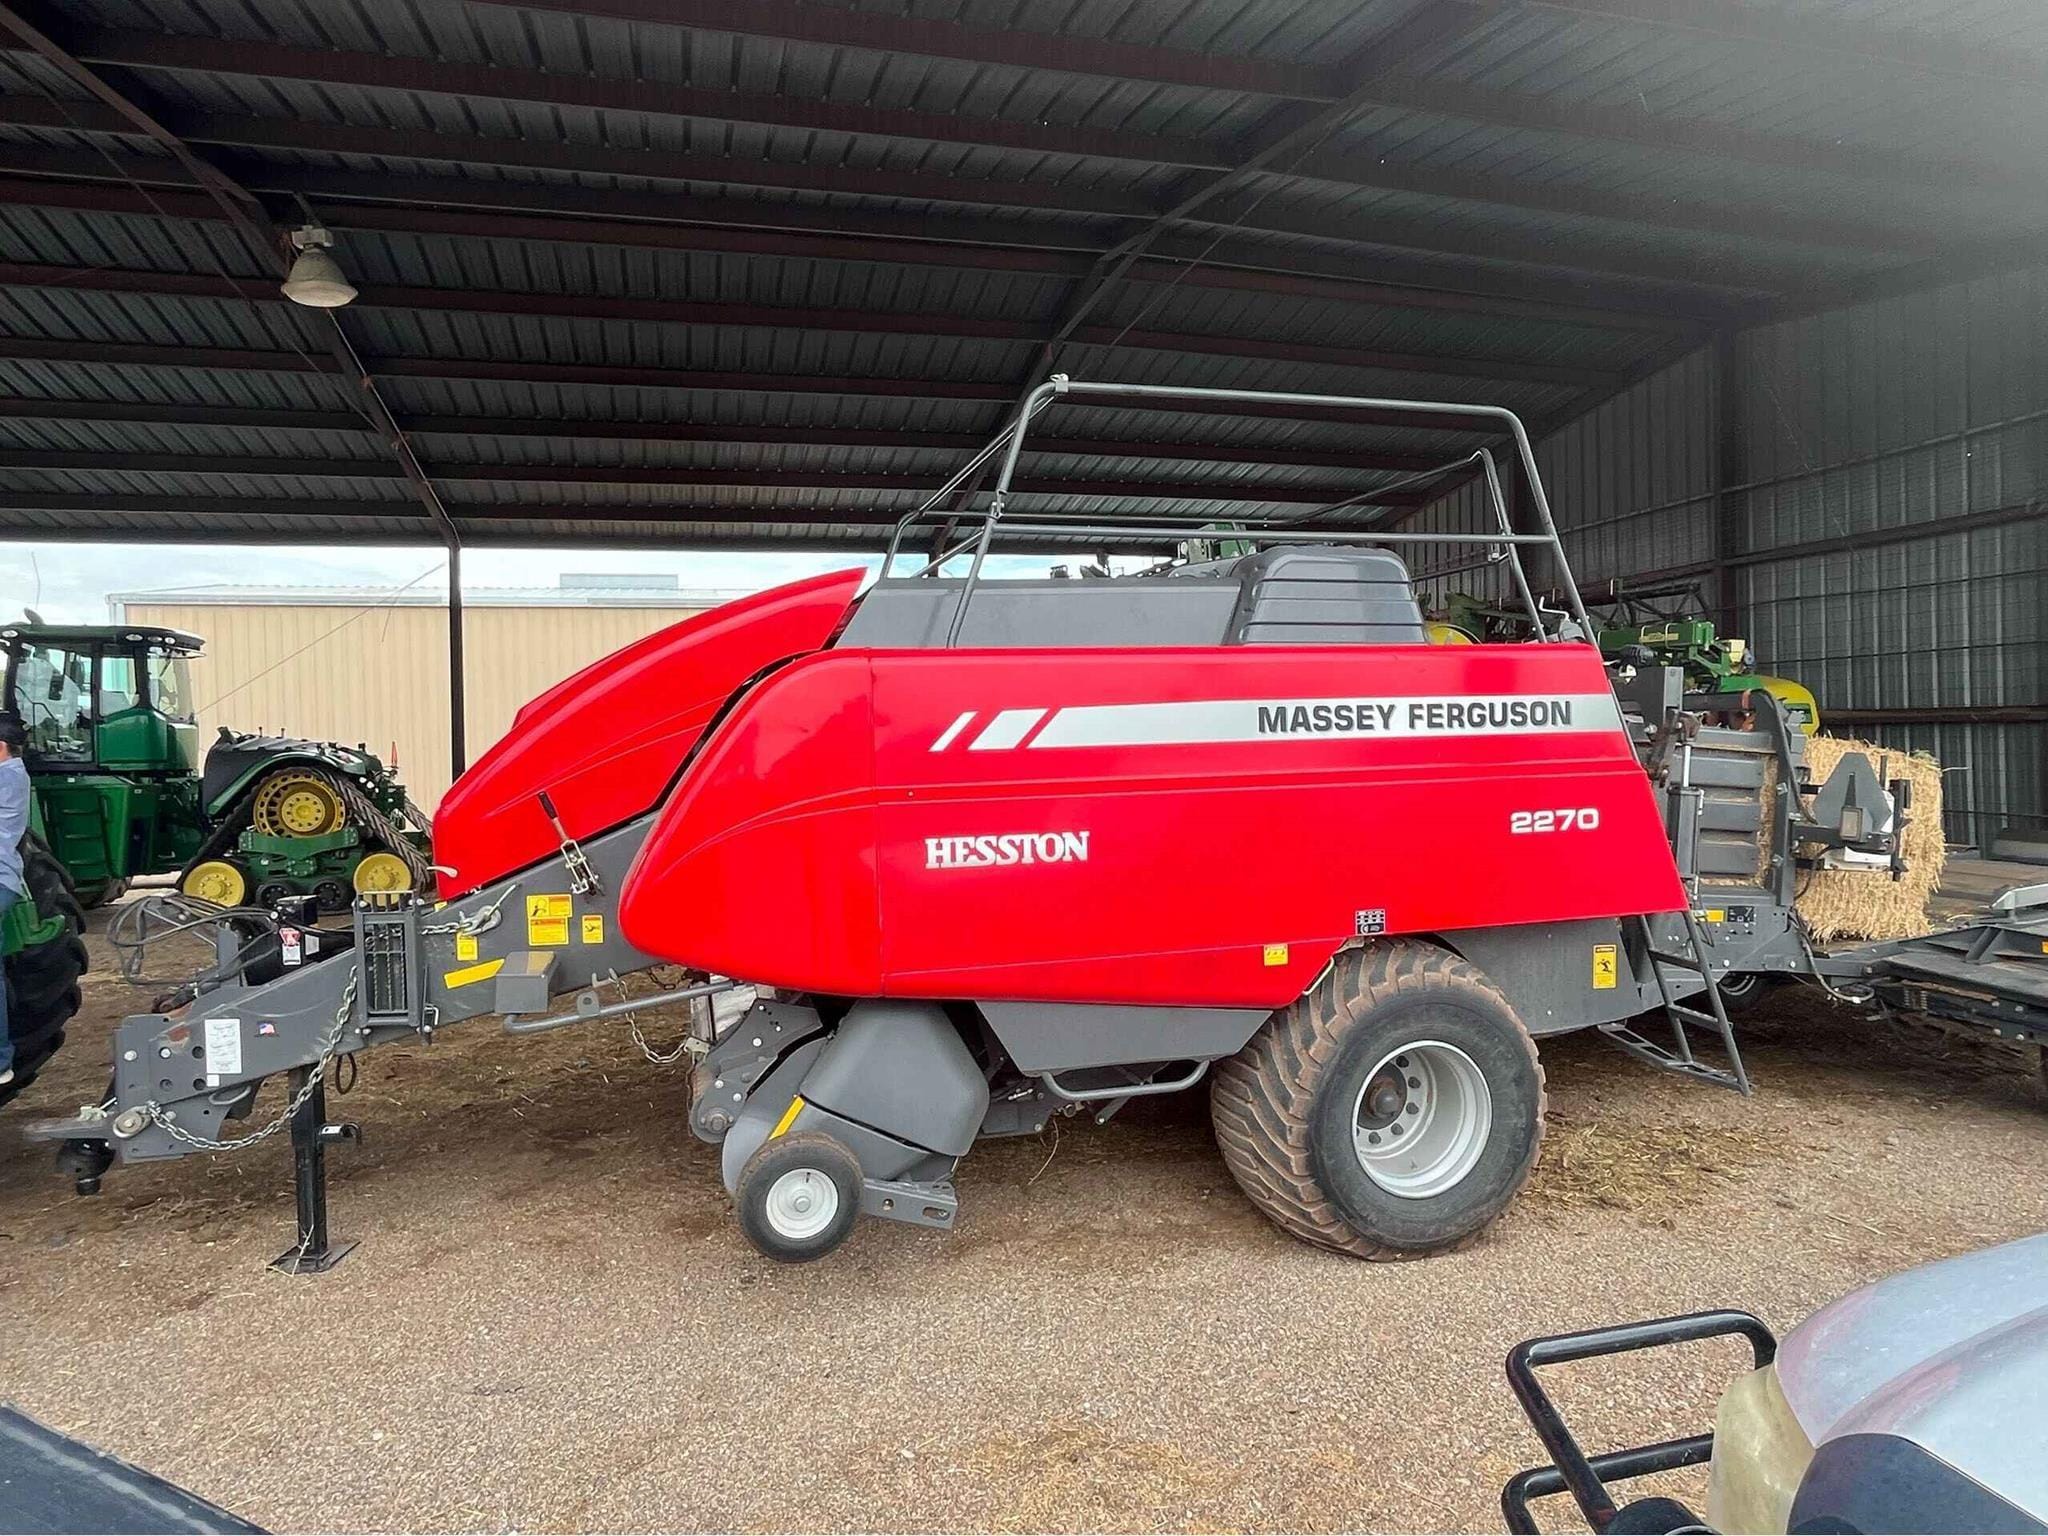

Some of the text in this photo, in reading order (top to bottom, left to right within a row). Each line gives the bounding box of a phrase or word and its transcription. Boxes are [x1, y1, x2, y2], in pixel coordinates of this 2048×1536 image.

[1257, 700, 1572, 733] MASSEY FERGUSON
[1510, 807, 1600, 834] 2270
[924, 830, 1090, 869] HESSTON
